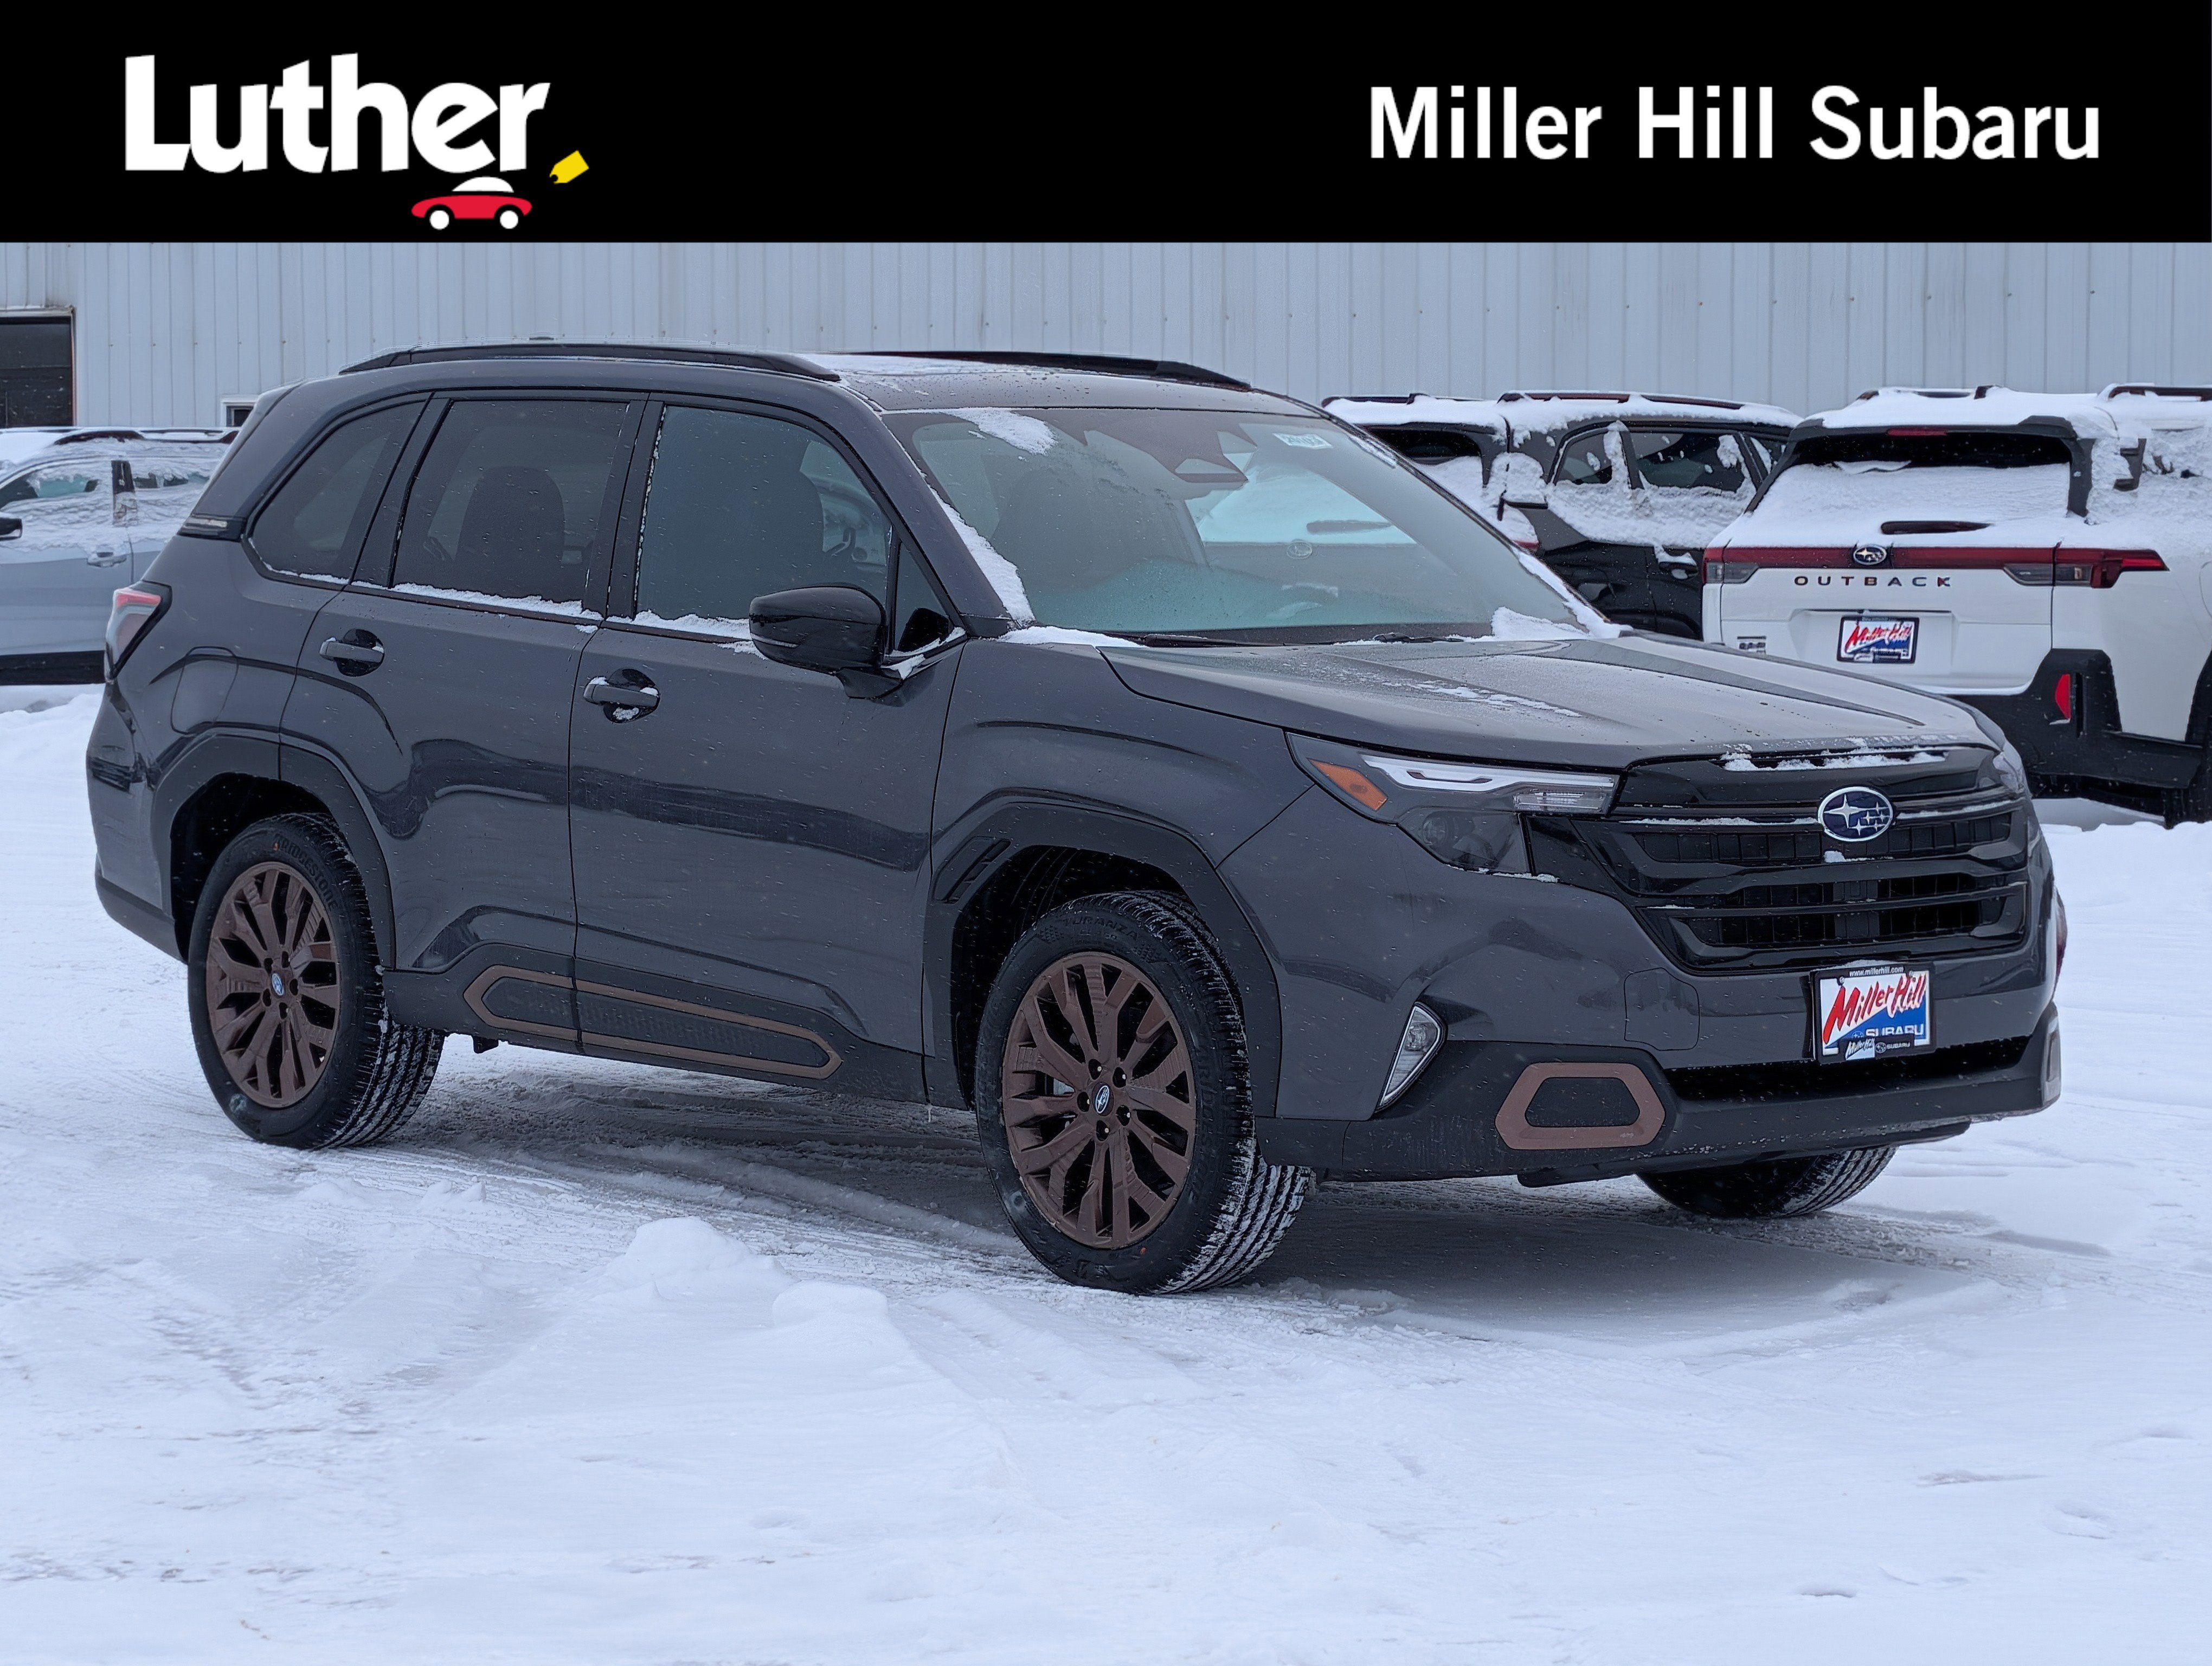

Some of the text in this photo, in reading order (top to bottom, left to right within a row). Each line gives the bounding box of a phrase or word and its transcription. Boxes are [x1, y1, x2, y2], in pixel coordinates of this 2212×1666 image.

[1794, 575, 1952, 587] OUTBACK
[1849, 966, 1904, 977] www.millerhill.com
[1823, 974, 1927, 1045] Miller Hill
